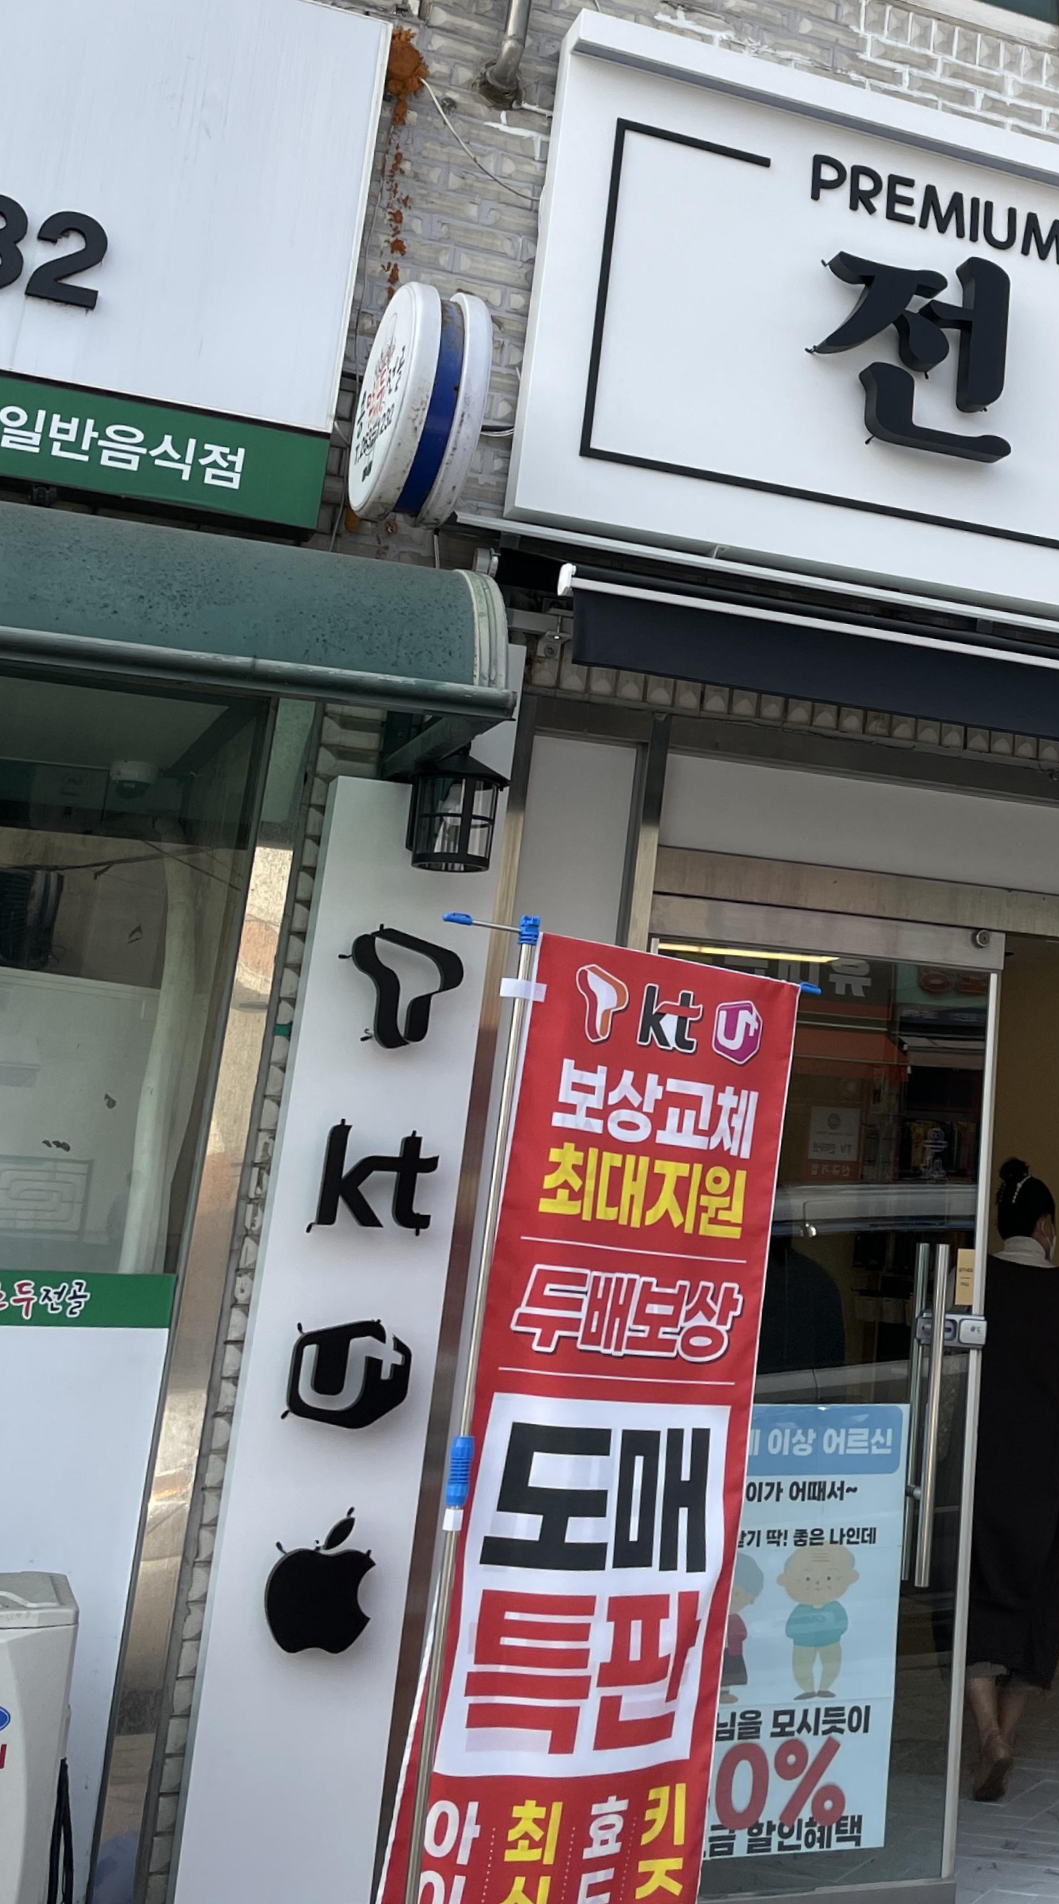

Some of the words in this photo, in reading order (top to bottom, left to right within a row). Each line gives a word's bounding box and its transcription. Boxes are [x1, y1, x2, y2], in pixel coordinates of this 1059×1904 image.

[0, 405, 245, 490] 일반음식점
[637, 983, 703, 1053] kt
[551, 1058, 759, 1160] 보상교체
[313, 1122, 440, 1231] kt
[538, 1142, 748, 1239] 최대지원
[0, 1279, 90, 1320] 두전골
[510, 1263, 745, 1363] 두배보상
[767, 1428, 816, 1456] 이상
[823, 1428, 892, 1456] 어르신
[478, 1420, 711, 1573] 도매
[766, 1529, 788, 1547] 딱!
[829, 1526, 877, 1546] 나인데
[464, 1588, 702, 1755] 특판
[715, 1709, 762, 1741] 님을
[770, 1705, 871, 1738] 모시듯이
[708, 1735, 846, 1831] 0%
[702, 1823, 736, 1858] 금
[746, 1814, 863, 1855] 할인혜택
